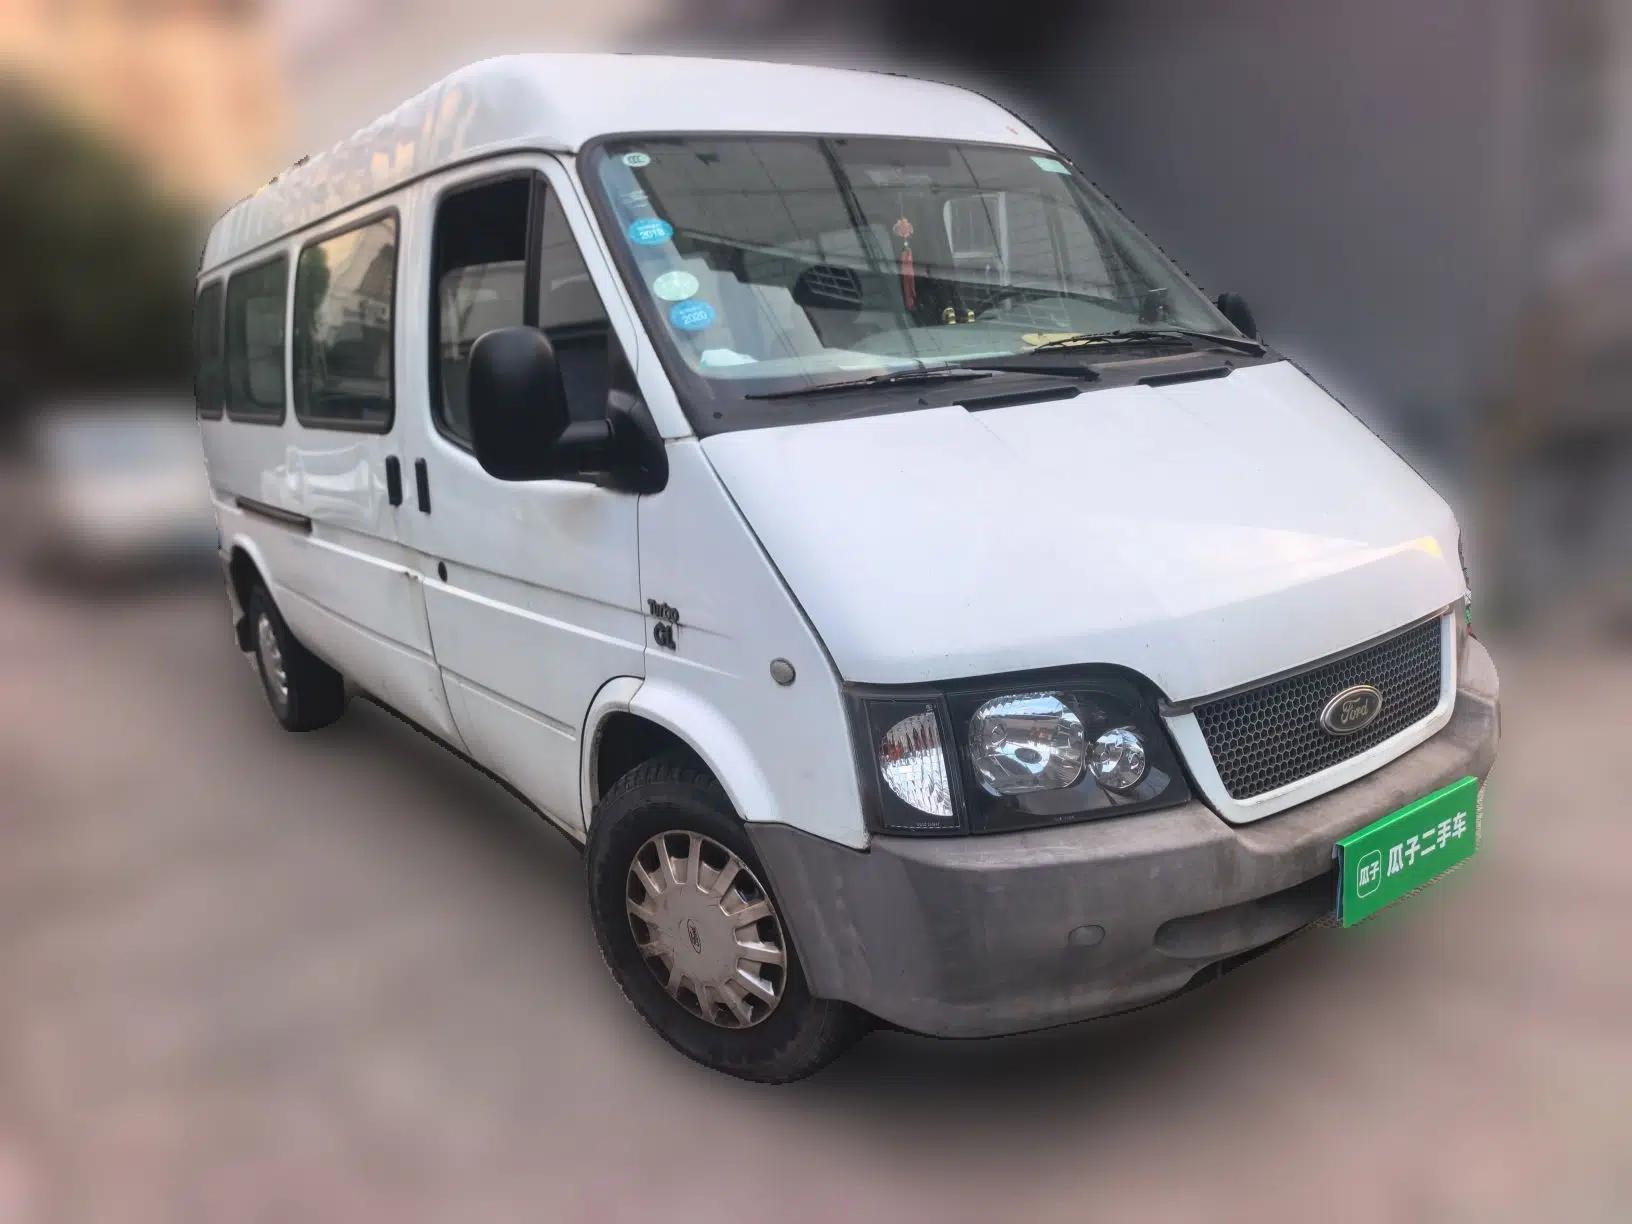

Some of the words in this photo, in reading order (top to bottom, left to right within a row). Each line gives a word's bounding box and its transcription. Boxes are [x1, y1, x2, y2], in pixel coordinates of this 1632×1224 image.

[682, 310, 709, 325] 2020
[1340, 698, 1369, 724] Ford
[1386, 811, 1468, 877] 瓜子二手车
[1358, 860, 1380, 887] 瓜子
